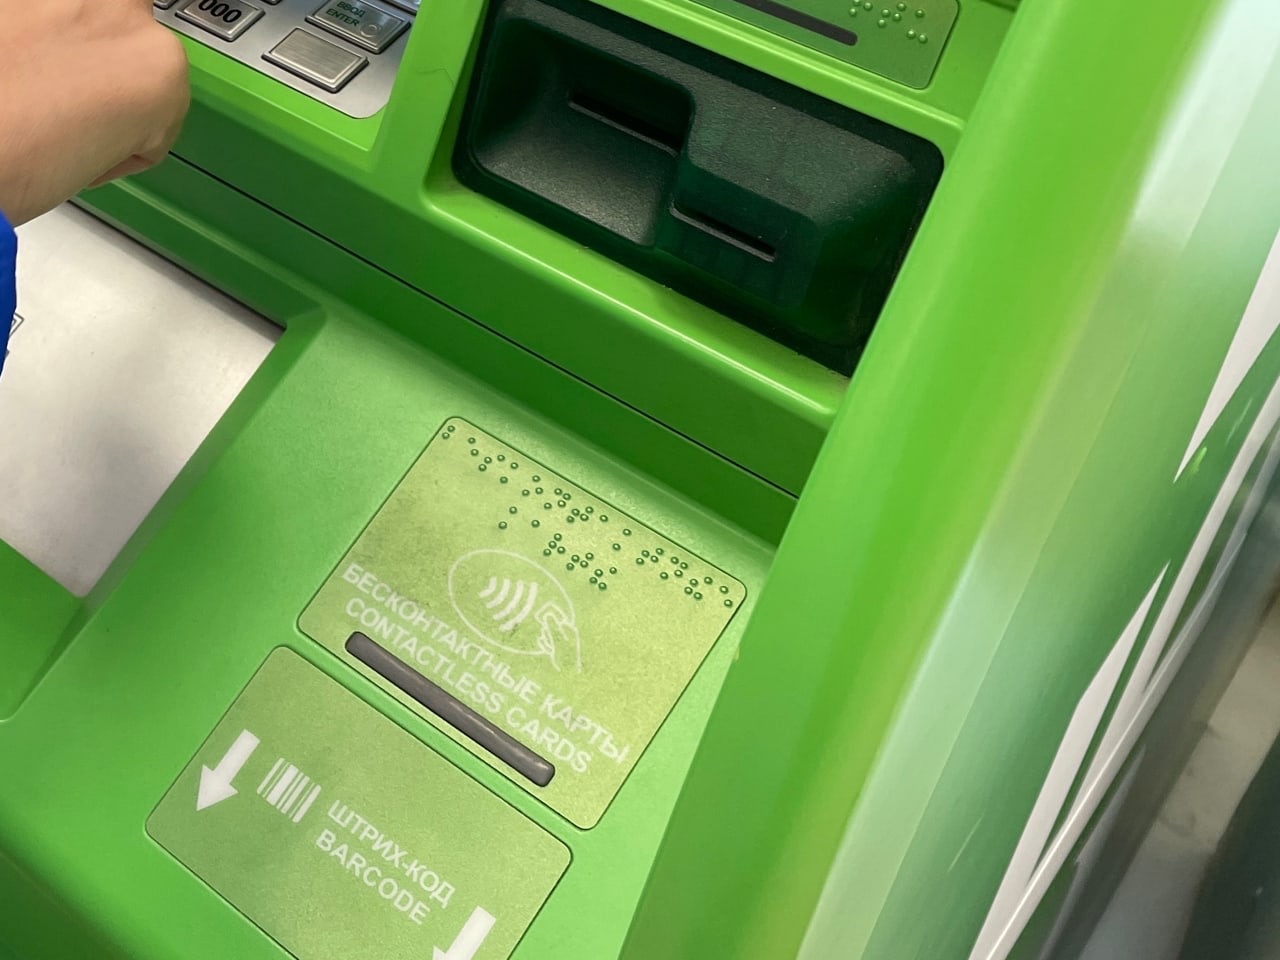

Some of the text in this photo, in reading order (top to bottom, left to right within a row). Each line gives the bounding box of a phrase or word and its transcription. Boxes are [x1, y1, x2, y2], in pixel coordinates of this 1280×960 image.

[326, 8, 360, 27] ENTER
[337, 0, 366, 18] ВВОД
[342, 563, 630, 764] БЕСКОНТАКТНЫЕ КАРТЫ
[345, 597, 592, 774] CONTACTLESS CARDS
[316, 828, 431, 926] BARCODE
[327, 799, 456, 910] ШТРИХ-КОД
